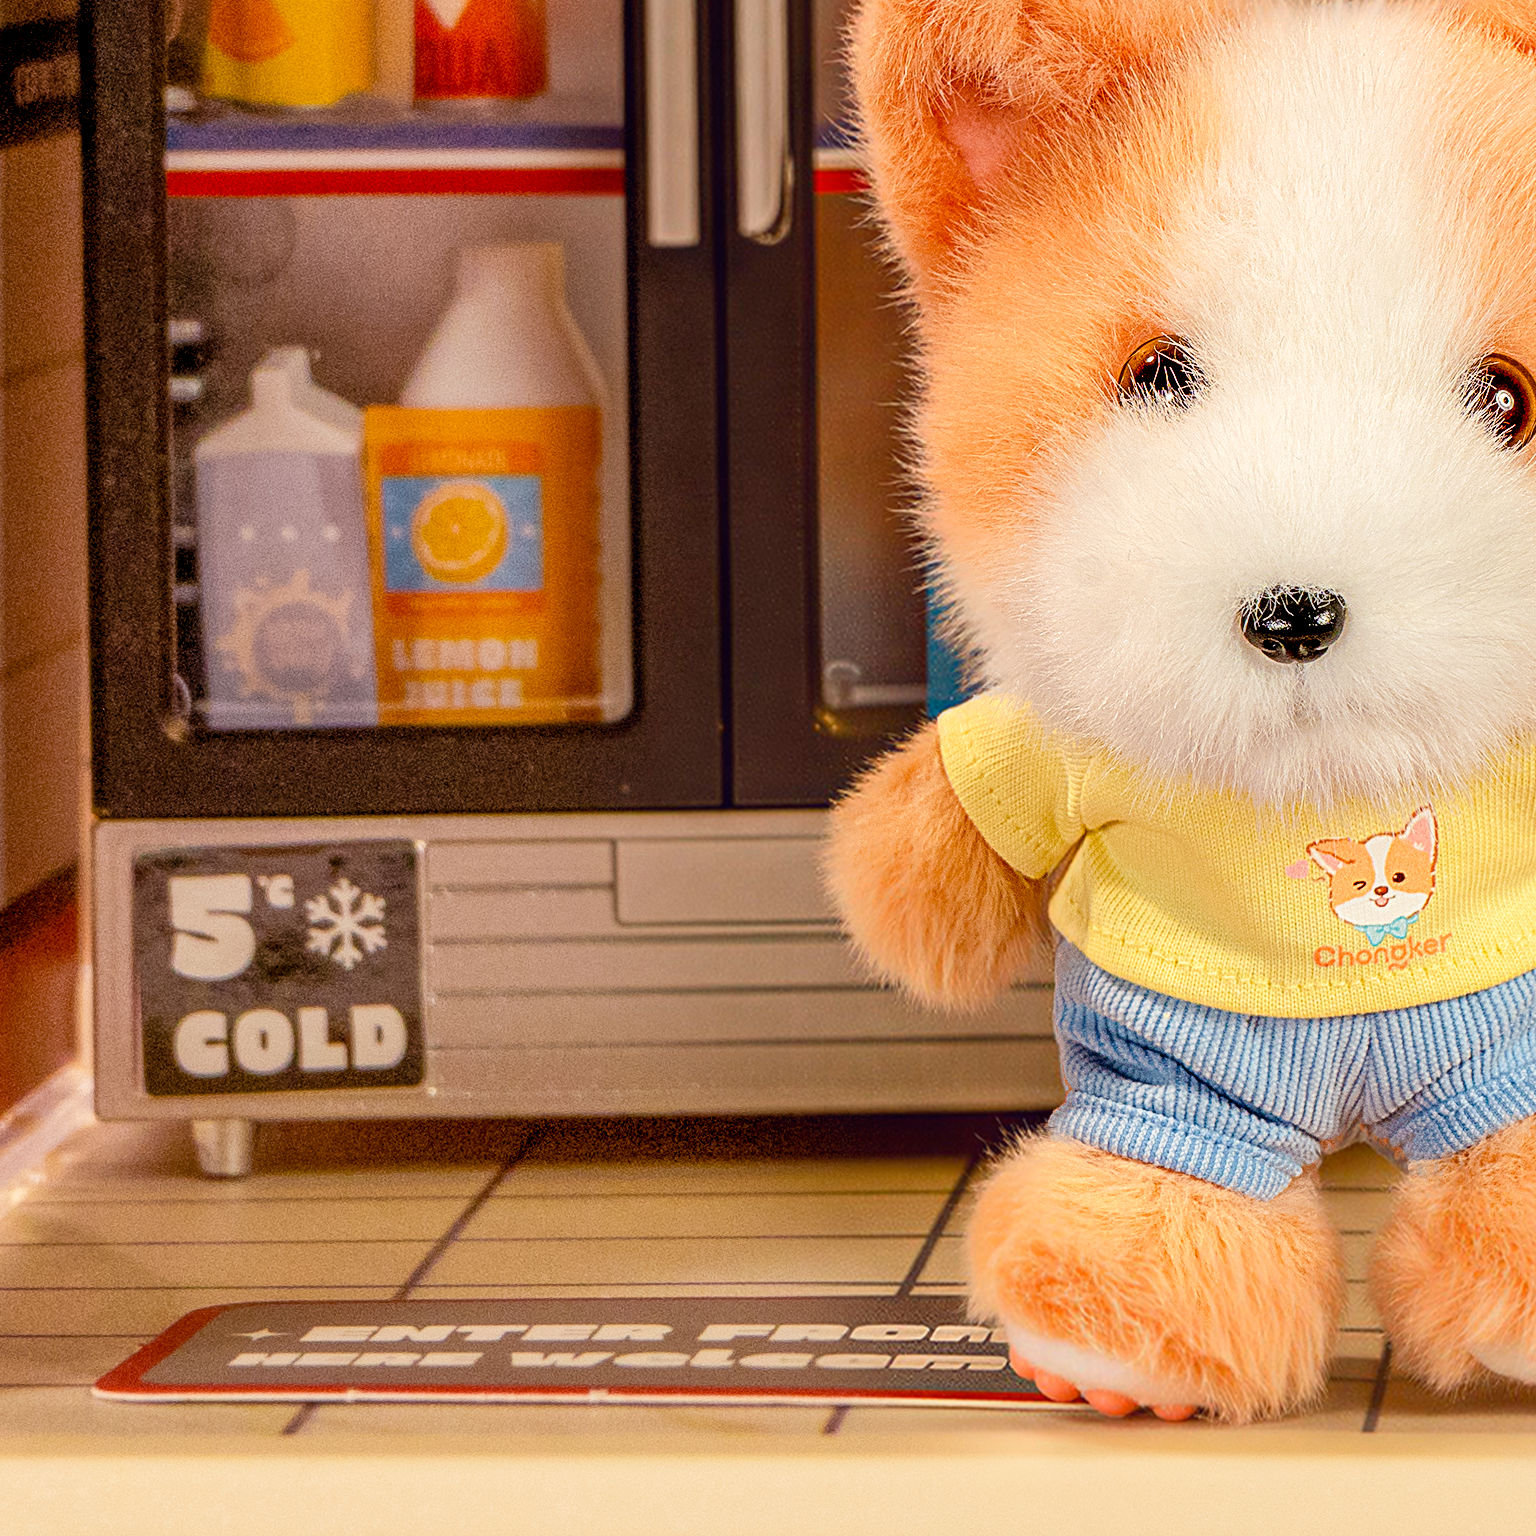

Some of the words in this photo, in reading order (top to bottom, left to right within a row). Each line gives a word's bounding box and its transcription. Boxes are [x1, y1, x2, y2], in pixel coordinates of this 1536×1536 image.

[1313, 933, 1453, 971] Chongker
[174, 1003, 408, 1079] COLD
[299, 1323, 674, 1342] ENTER
[511, 1348, 1008, 1371] Welcom
